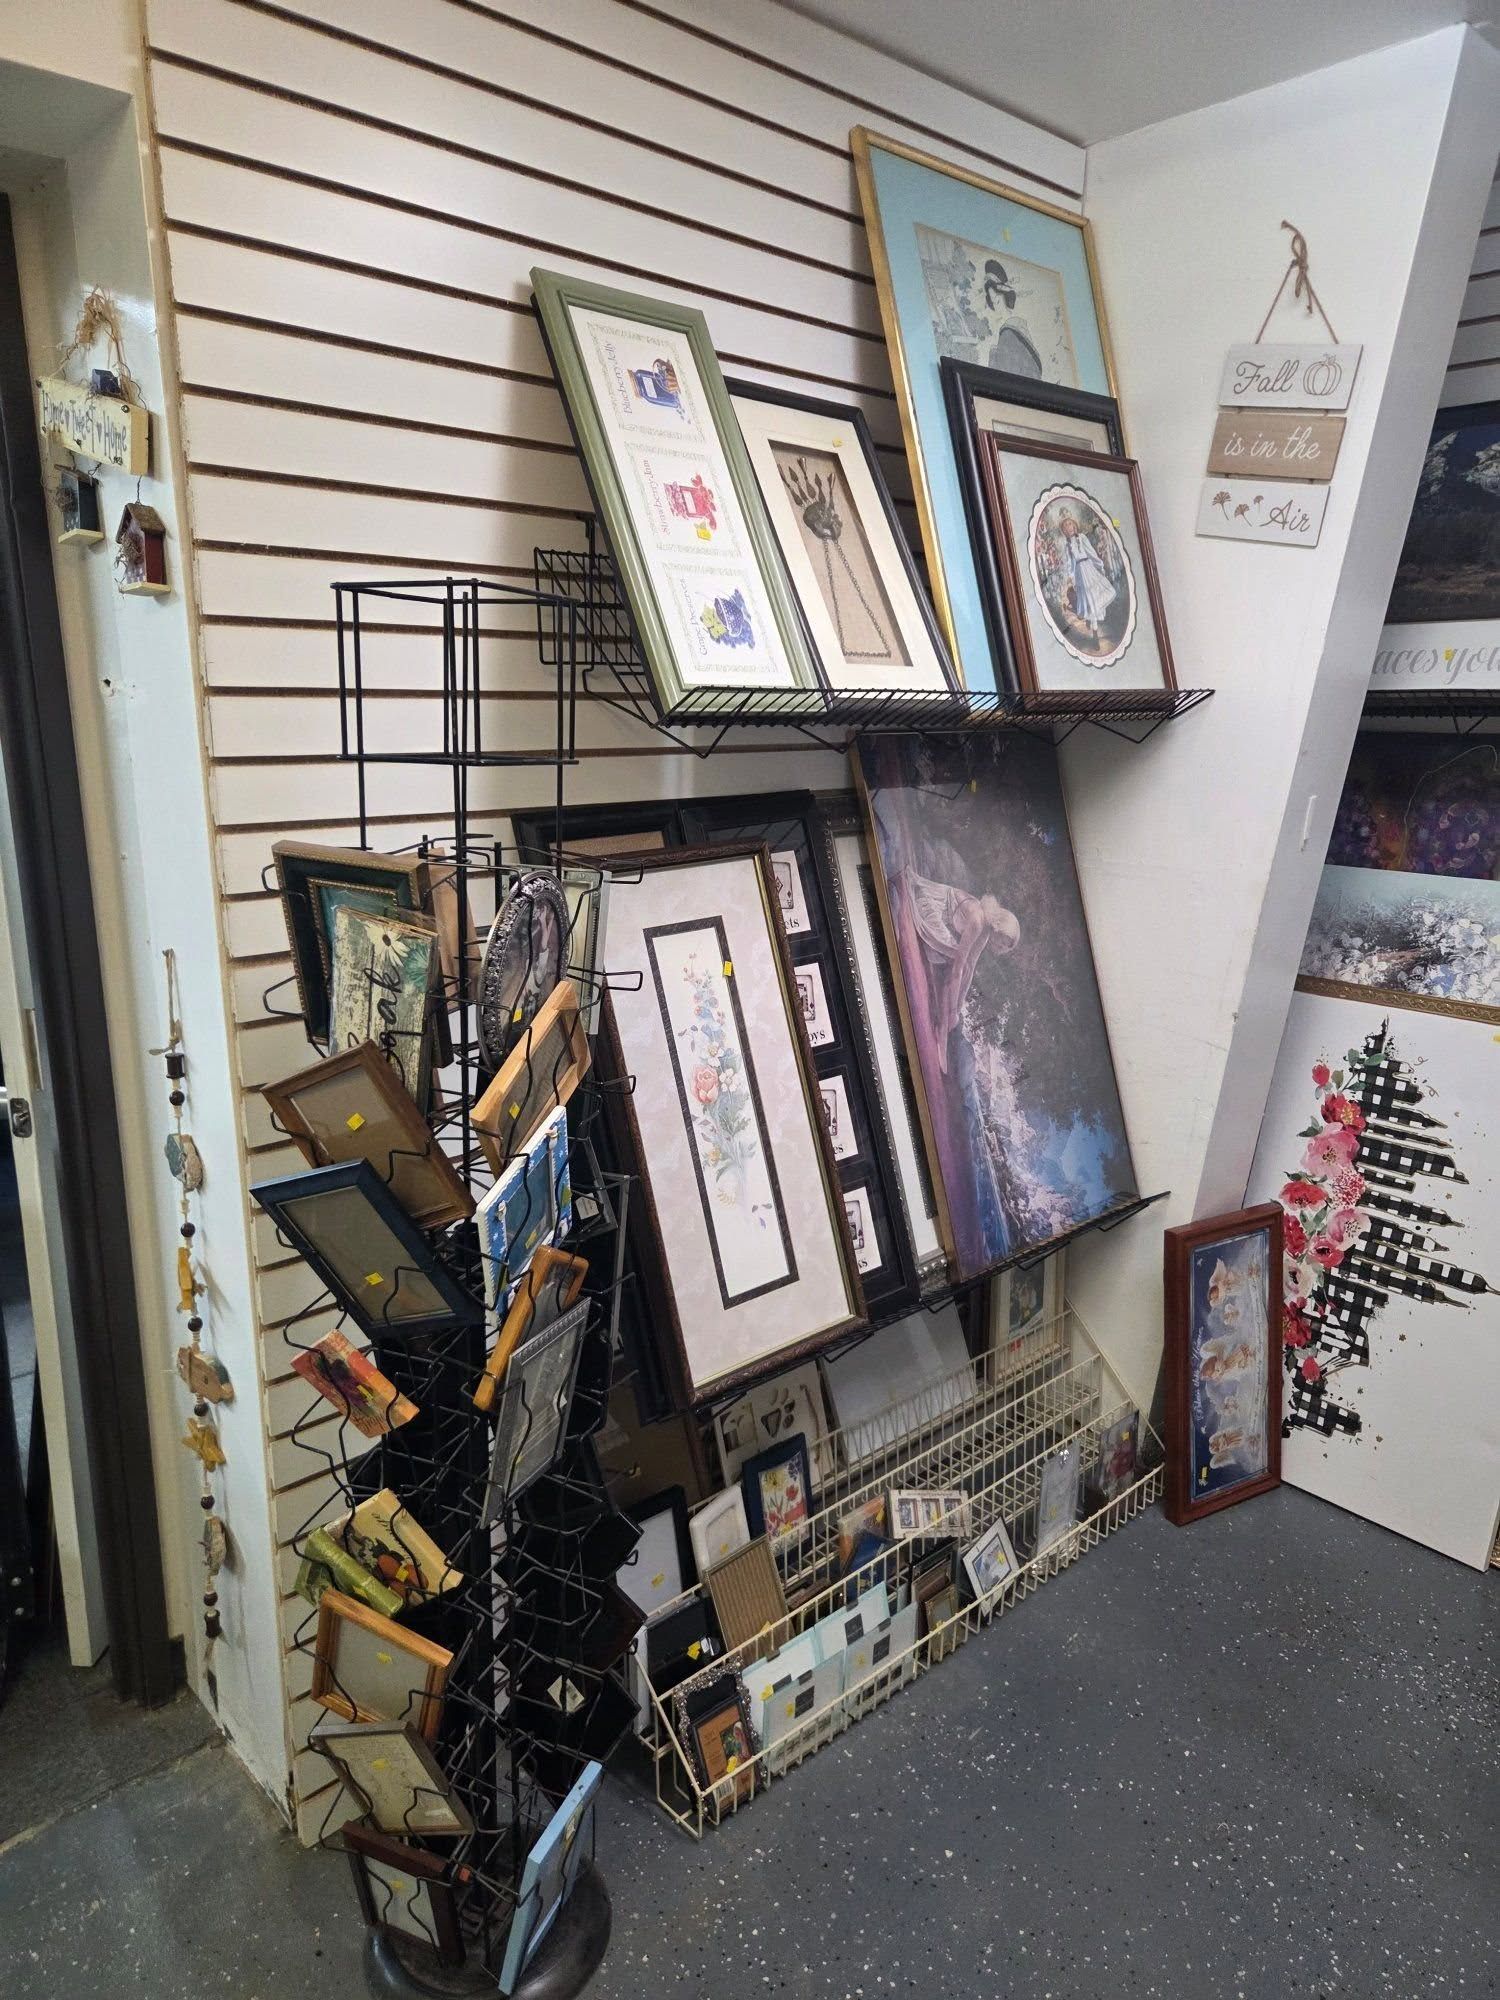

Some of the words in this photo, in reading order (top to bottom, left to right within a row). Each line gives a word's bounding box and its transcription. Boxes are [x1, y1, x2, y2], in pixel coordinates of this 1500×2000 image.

[604, 342, 617, 366] Jelly
[613, 366, 632, 414] Blueberry
[1233, 359, 1300, 395] Fall
[1223, 431, 1245, 456] is
[1250, 433, 1278, 458] in
[1282, 425, 1321, 460] the
[643, 459, 654, 480] Jam
[649, 481, 670, 536] Strawberry
[1259, 499, 1311, 532] Air
